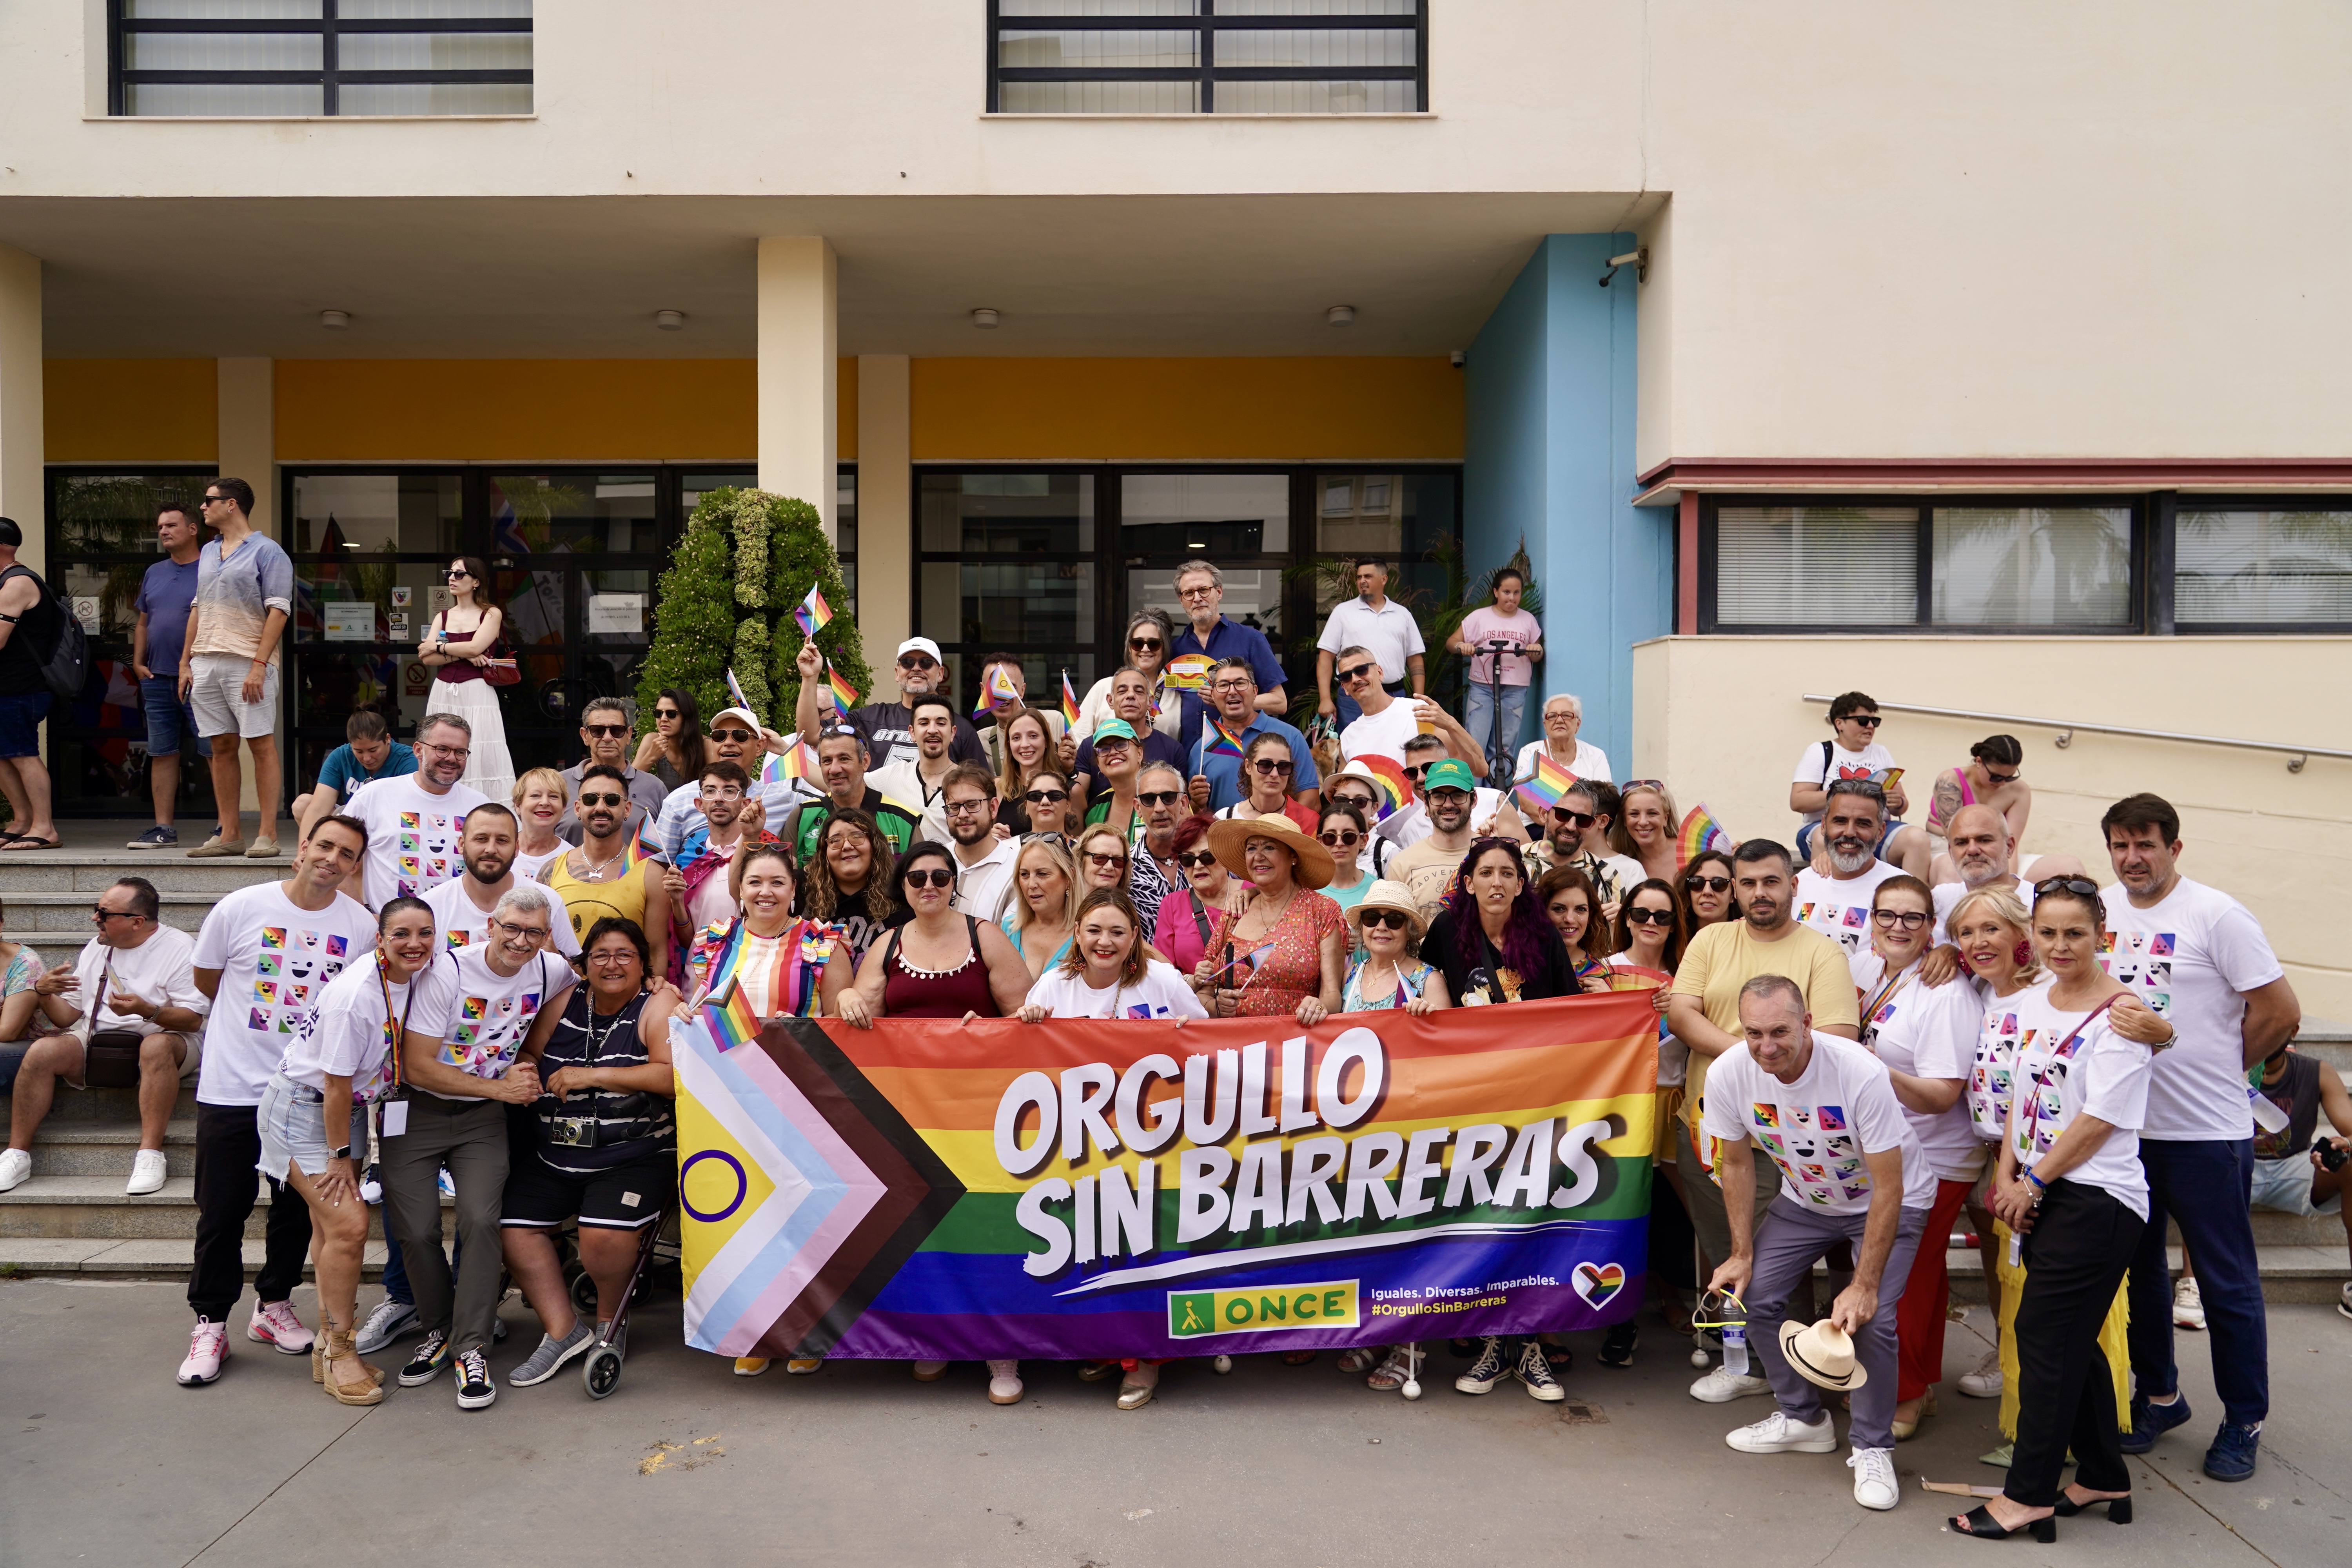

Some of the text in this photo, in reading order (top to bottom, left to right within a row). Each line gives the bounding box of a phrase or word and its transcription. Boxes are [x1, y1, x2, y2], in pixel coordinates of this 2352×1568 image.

[1483, 630, 1526, 644] LOS ANGELES
[993, 1027, 1383, 1174] ORGULLO
[1015, 1118, 1611, 1277] SIN BARRERAS
[1372, 1275, 1559, 1301] Iguales. Diversas. Imparables.
[1225, 1290, 1346, 1325] ONCE
[1372, 1295, 1506, 1317] #OrgulloSinBarreras
